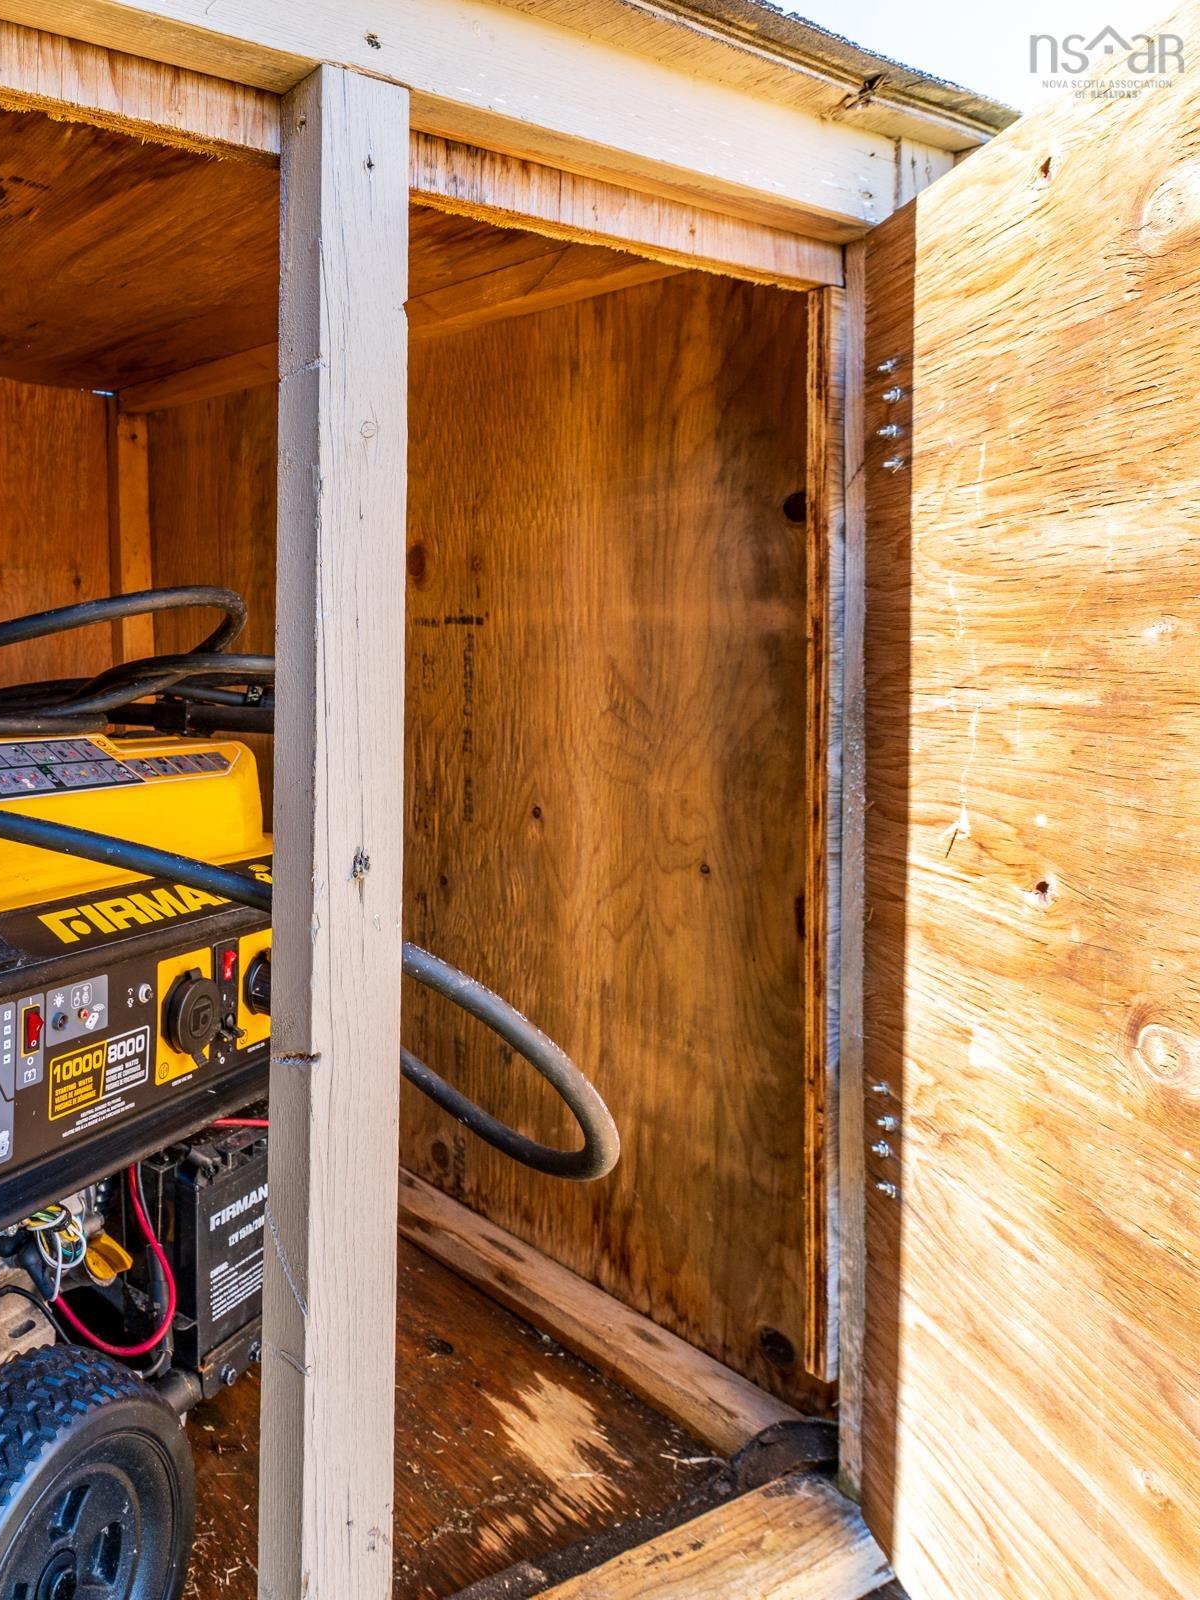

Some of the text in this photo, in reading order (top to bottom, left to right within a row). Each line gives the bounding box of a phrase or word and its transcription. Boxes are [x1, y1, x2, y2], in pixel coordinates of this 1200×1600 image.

[53, 1050, 103, 1083] 10000
[107, 1034, 145, 1064] 8000
[210, 1183, 268, 1232] FIRMAN
